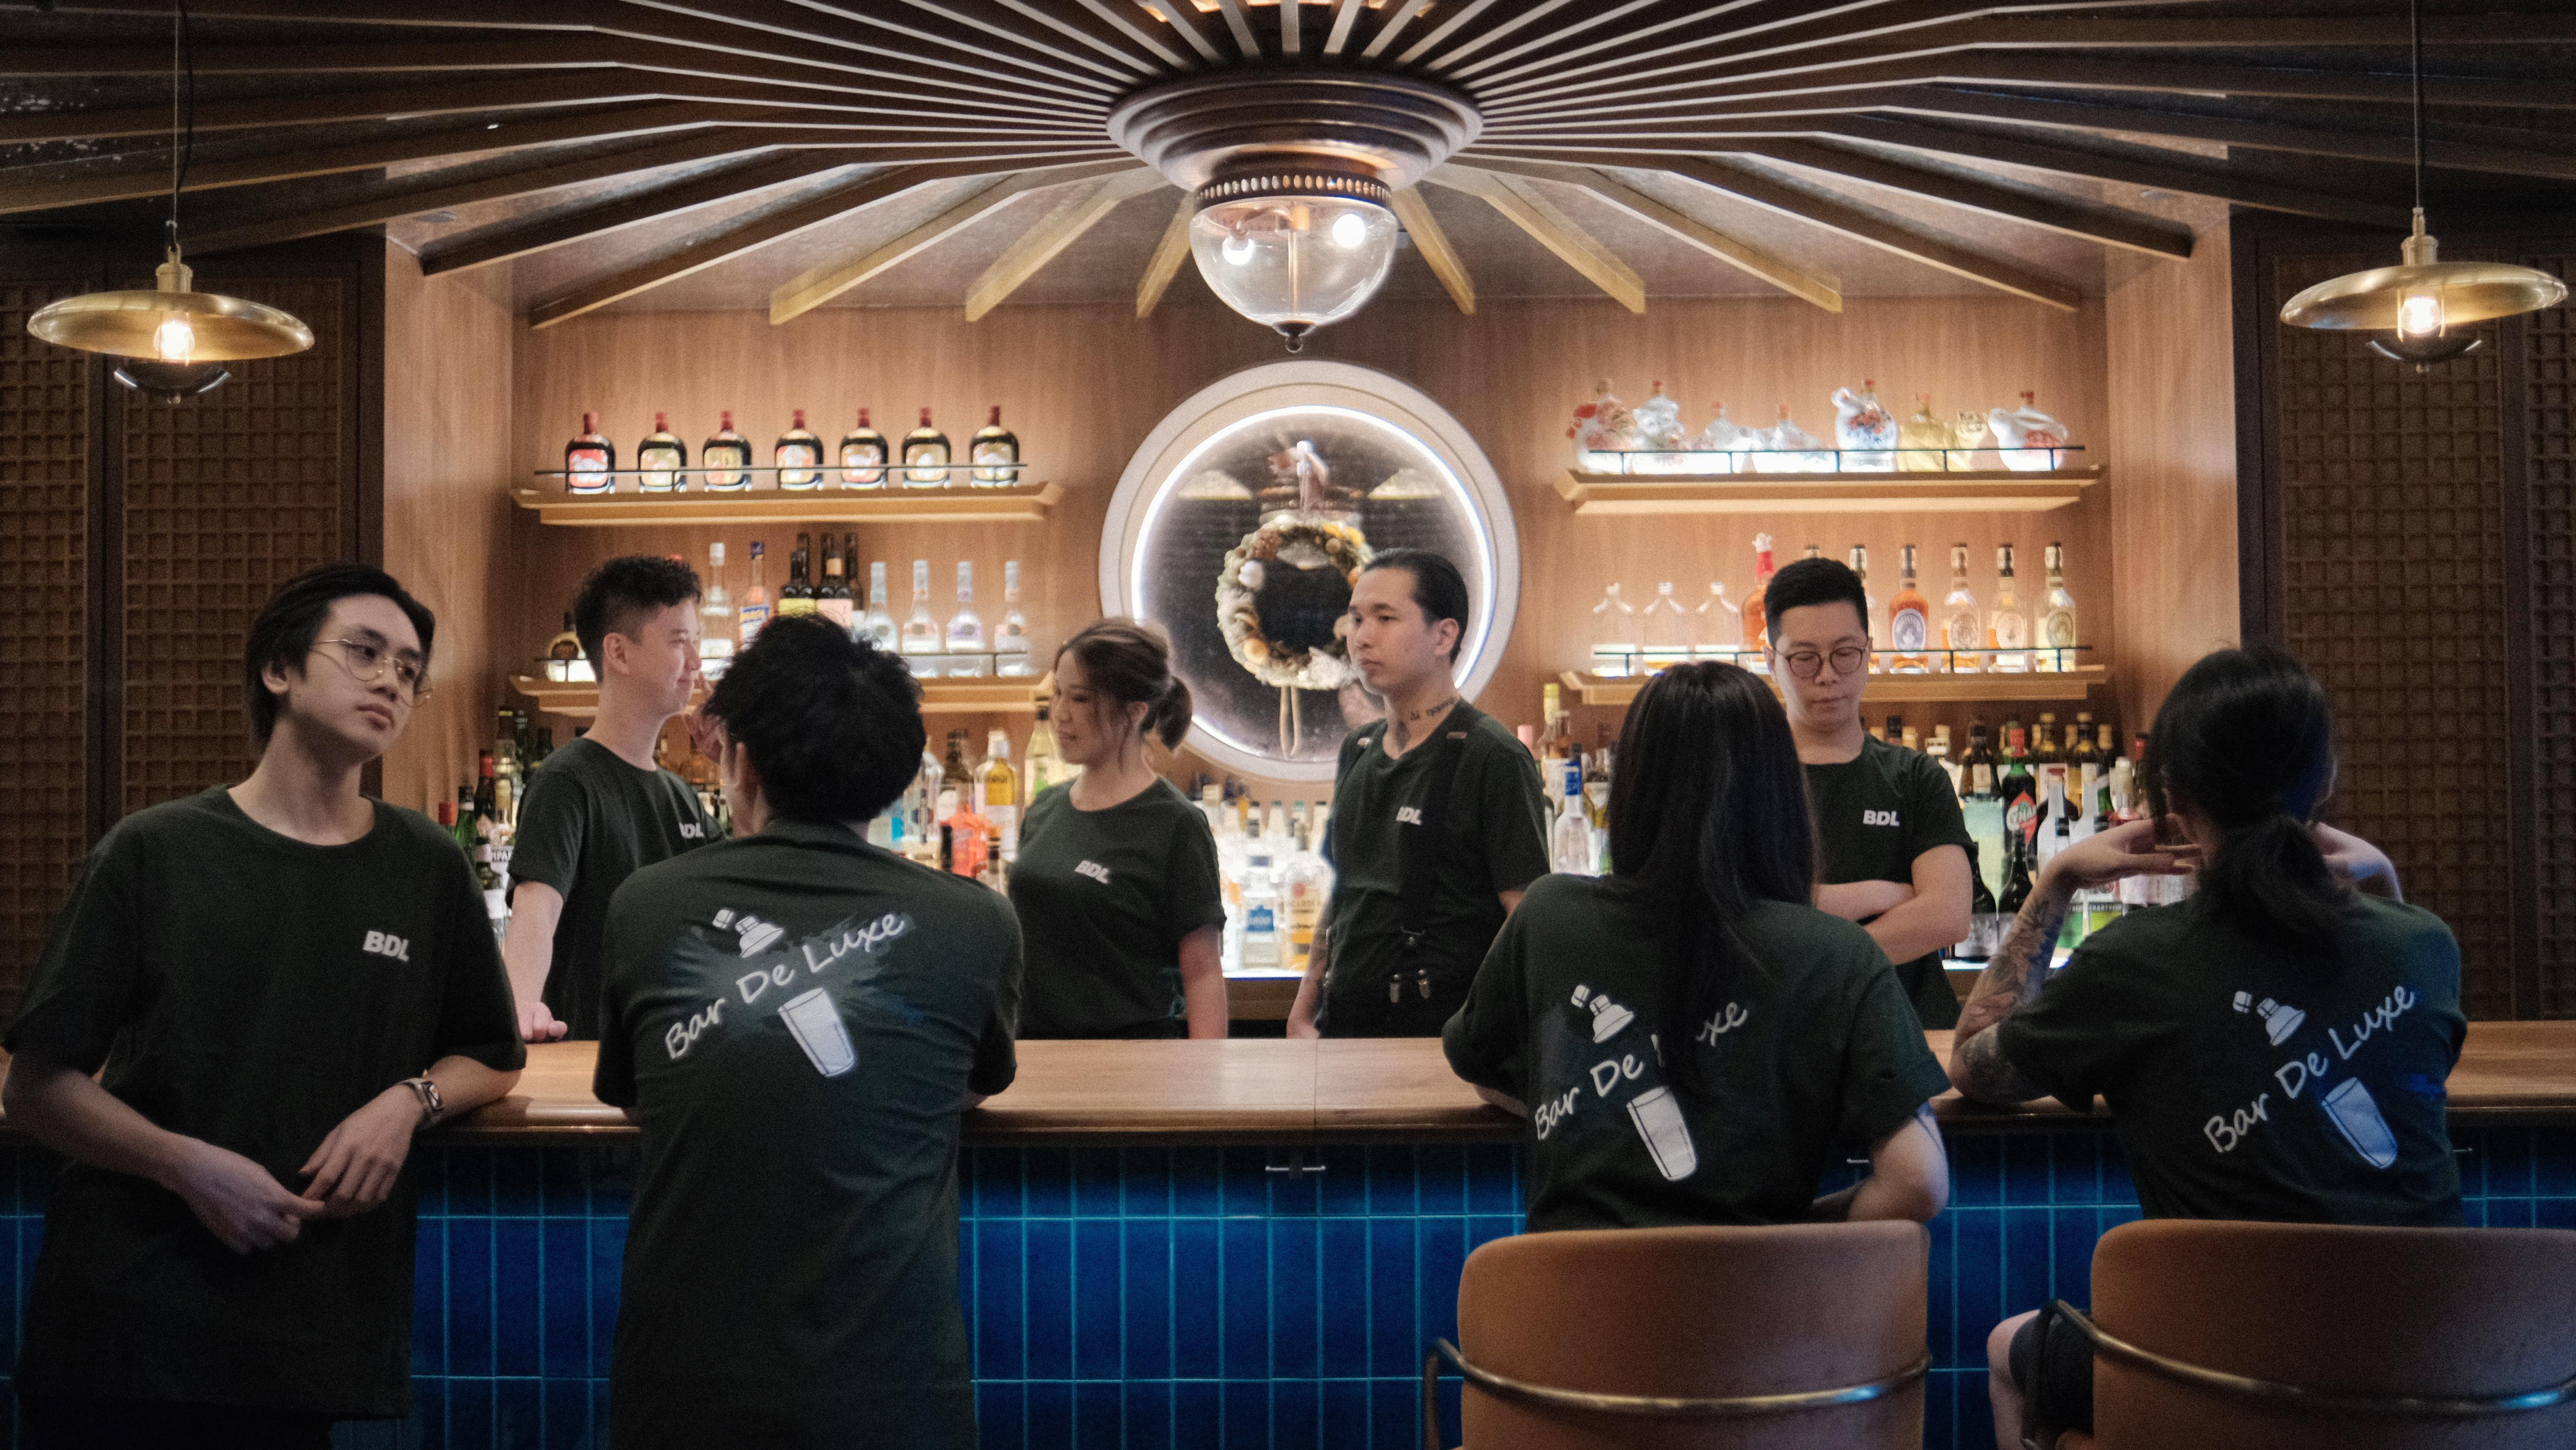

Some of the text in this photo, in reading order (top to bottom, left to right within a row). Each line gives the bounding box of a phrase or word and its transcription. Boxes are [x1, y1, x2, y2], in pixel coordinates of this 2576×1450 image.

[679, 822, 705, 839] DL
[1863, 809, 1900, 827] BDL
[1074, 859, 1110, 884] BDL
[363, 930, 410, 962] BDL
[665, 912, 906, 1059] Bar De Luxe
[2204, 985, 2415, 1153] Bar De Luxe
[1535, 1087, 1580, 1140] Bar
[1590, 1053, 1644, 1098] De
